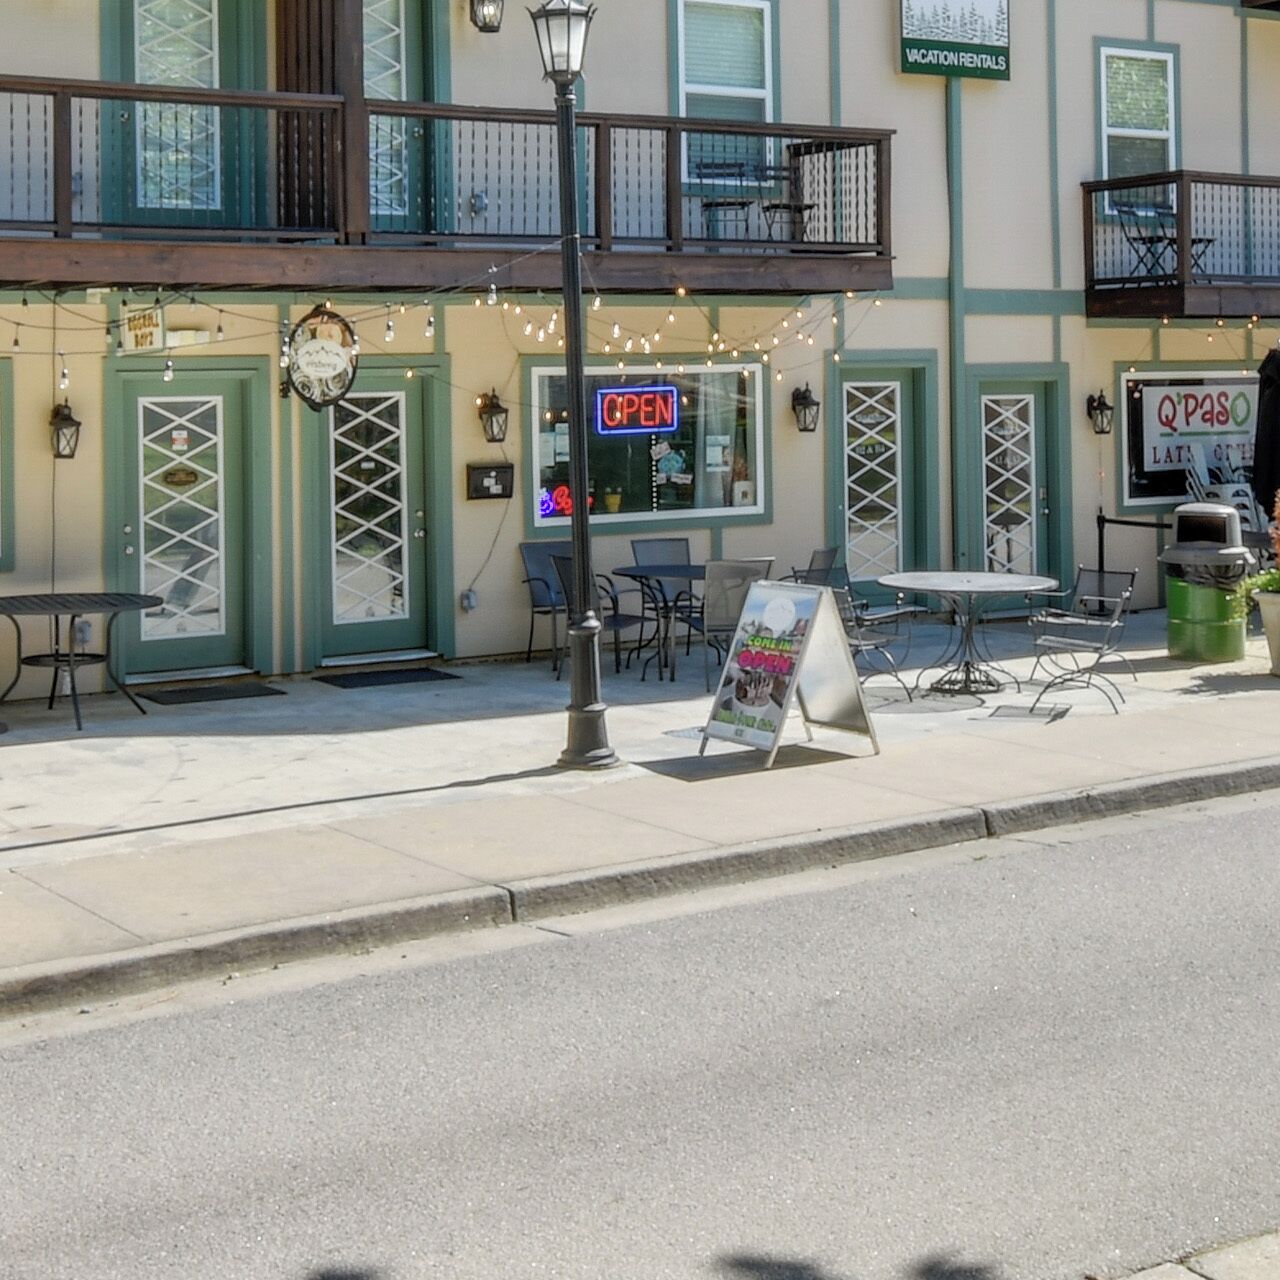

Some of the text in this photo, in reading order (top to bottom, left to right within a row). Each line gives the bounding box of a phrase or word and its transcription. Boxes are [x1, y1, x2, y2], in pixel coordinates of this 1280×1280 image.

[905, 48, 1007, 71] VACATION RENTALS
[603, 393, 673, 427] OPEN
[748, 635, 793, 651] COME IN
[738, 650, 793, 676] OPEN
